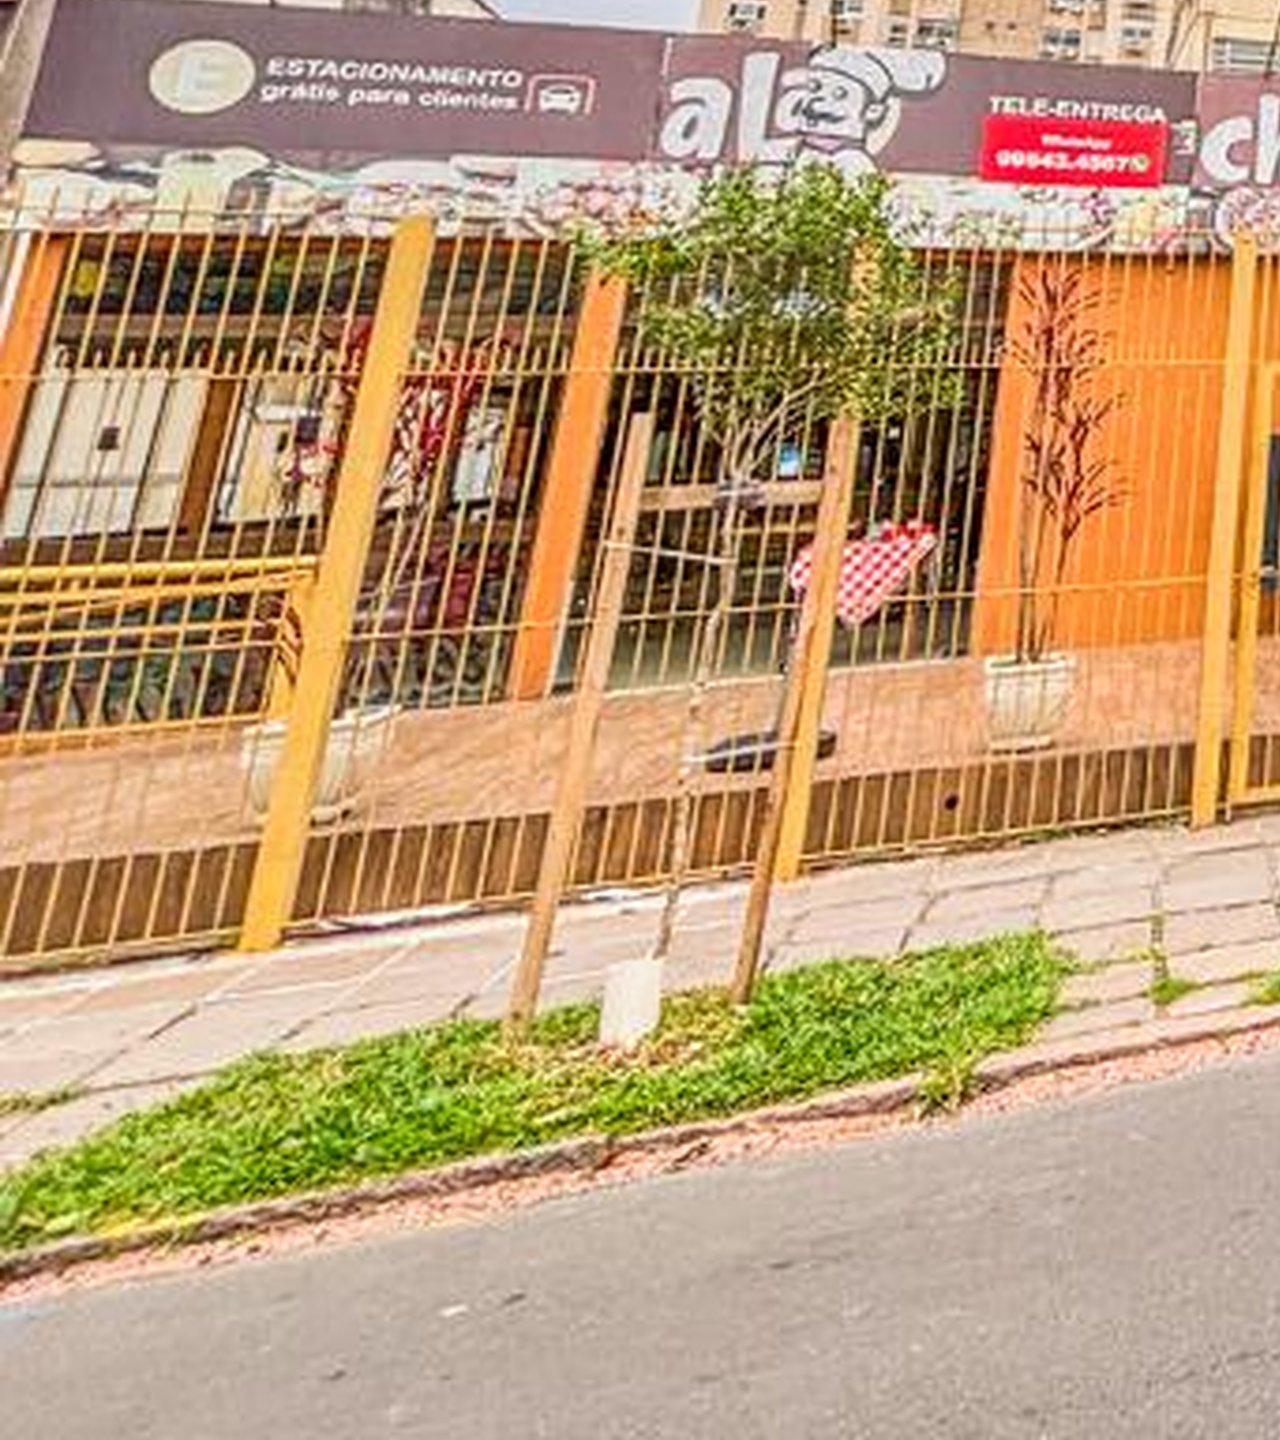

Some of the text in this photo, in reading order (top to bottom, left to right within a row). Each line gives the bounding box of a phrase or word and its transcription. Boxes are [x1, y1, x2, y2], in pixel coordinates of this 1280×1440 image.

[267, 58, 523, 89] ESTACIONAMENTO
[260, 82, 519, 110] grátis para clientes
[989, 96, 1167, 123] TELE-ENTREGA
